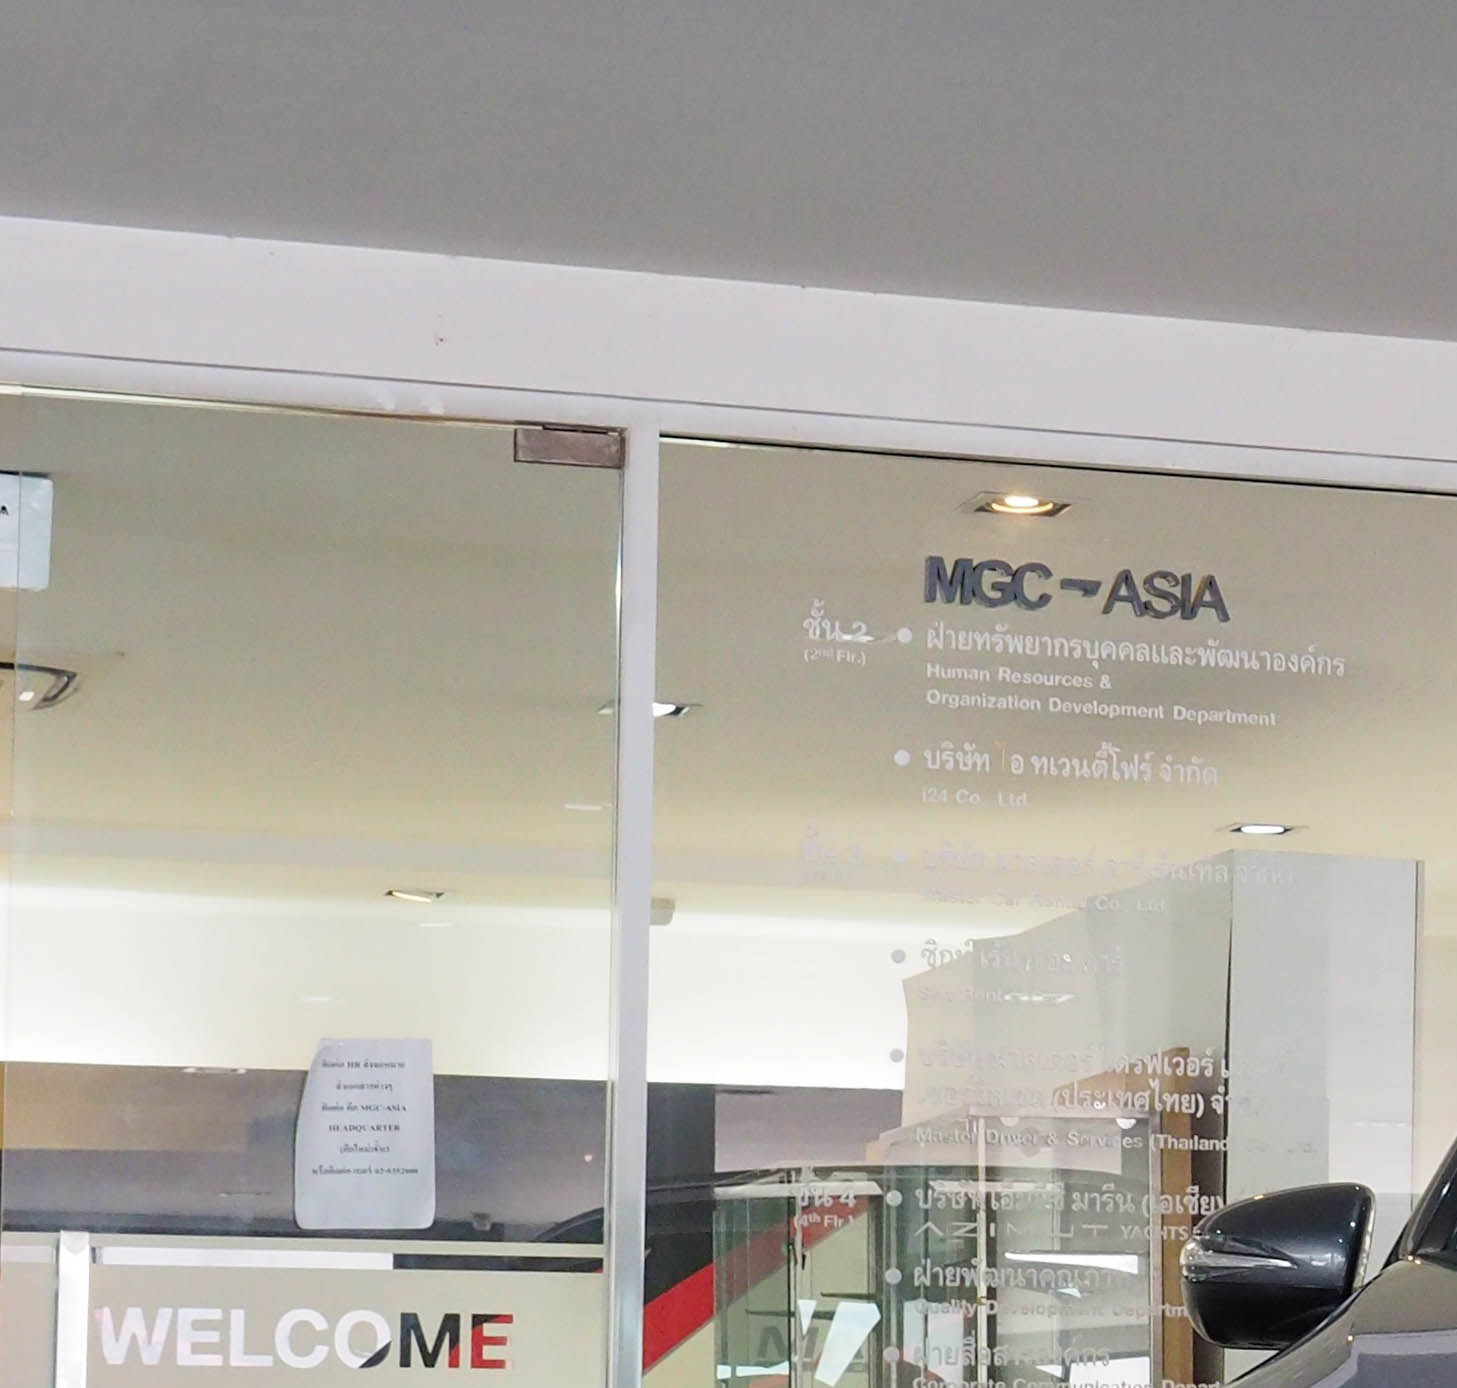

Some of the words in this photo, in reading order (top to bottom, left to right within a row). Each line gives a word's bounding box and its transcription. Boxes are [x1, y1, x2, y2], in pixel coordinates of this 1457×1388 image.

[926, 662, 990, 682] Human
[998, 667, 1093, 689] Resources
[1100, 674, 1112, 689] &
[926, 689, 1041, 712] Organization
[1049, 698, 1164, 719] Development
[1173, 705, 1277, 726] Department
[922, 740, 990, 773] บริษัท
[96, 1306, 514, 1369] WELCOME
